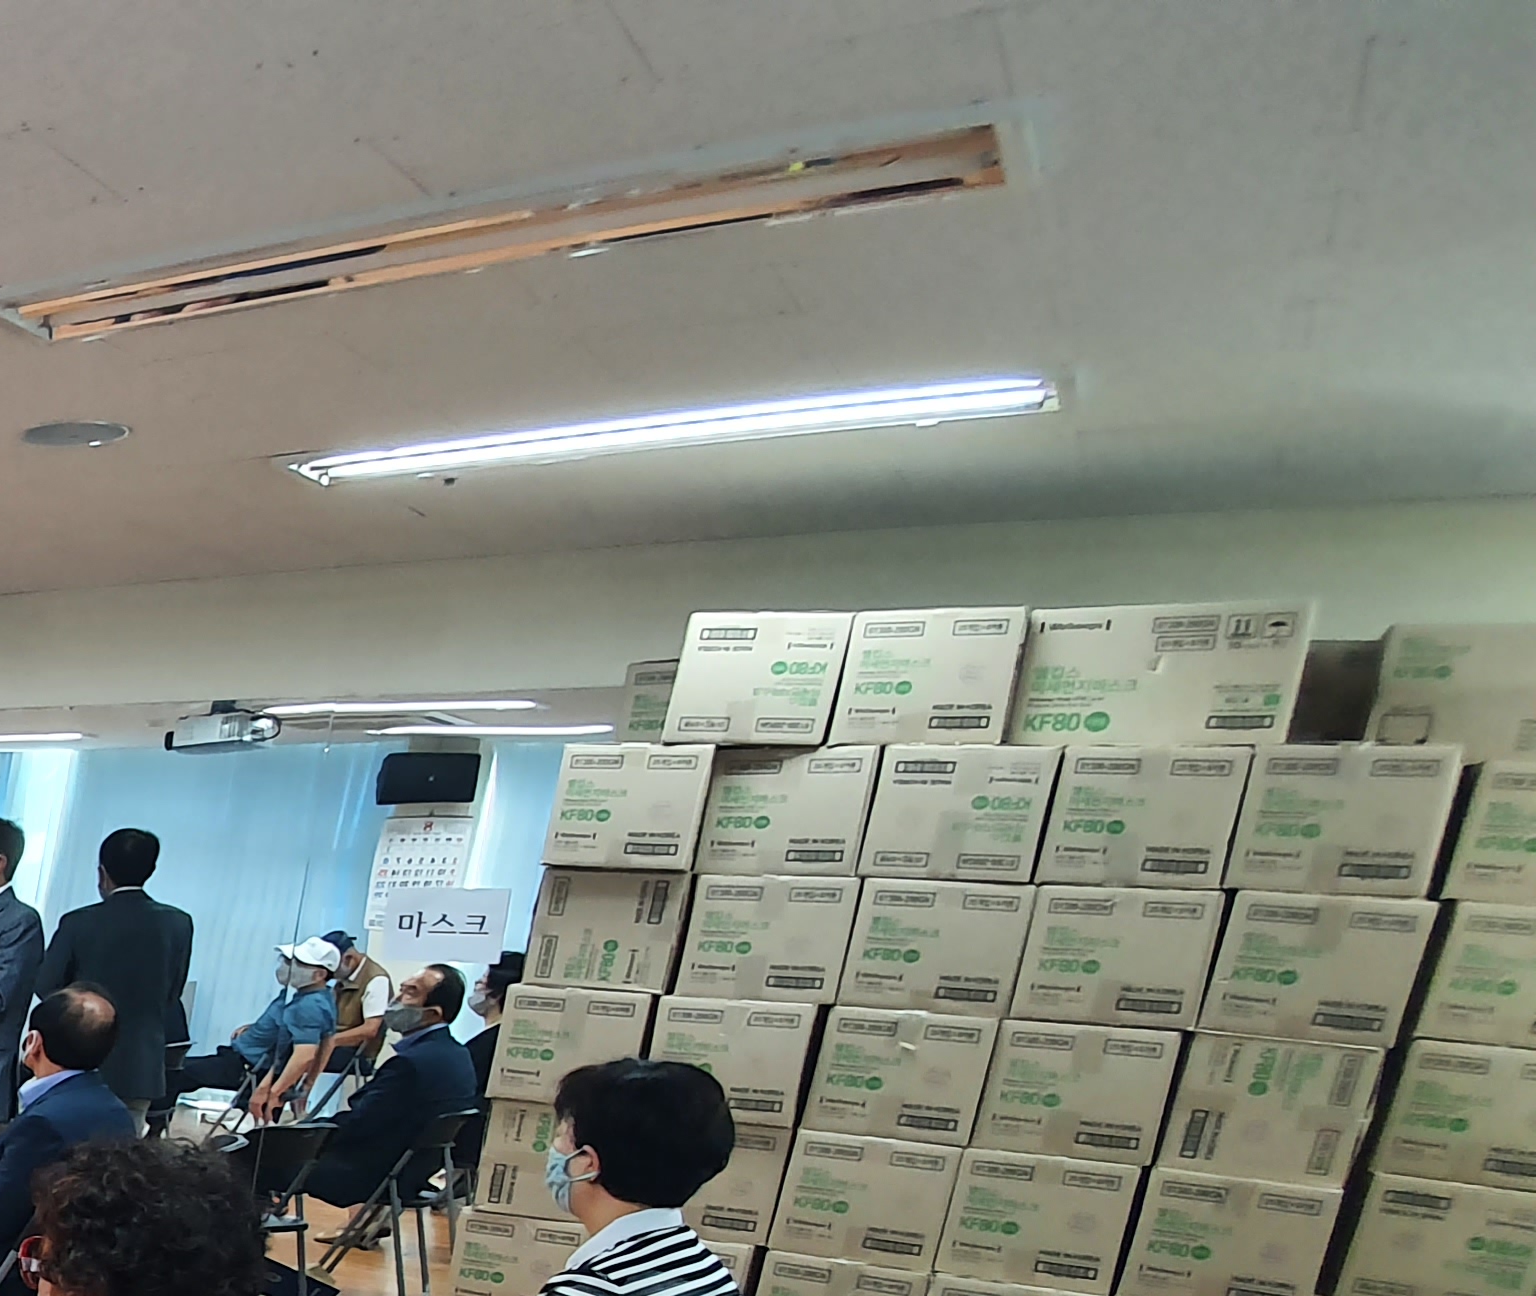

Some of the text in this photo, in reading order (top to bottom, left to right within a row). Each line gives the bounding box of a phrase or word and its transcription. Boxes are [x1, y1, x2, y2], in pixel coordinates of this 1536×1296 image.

[1023, 711, 1081, 732] KF80
[560, 809, 594, 821] KF80
[398, 911, 489, 938] 마스크
